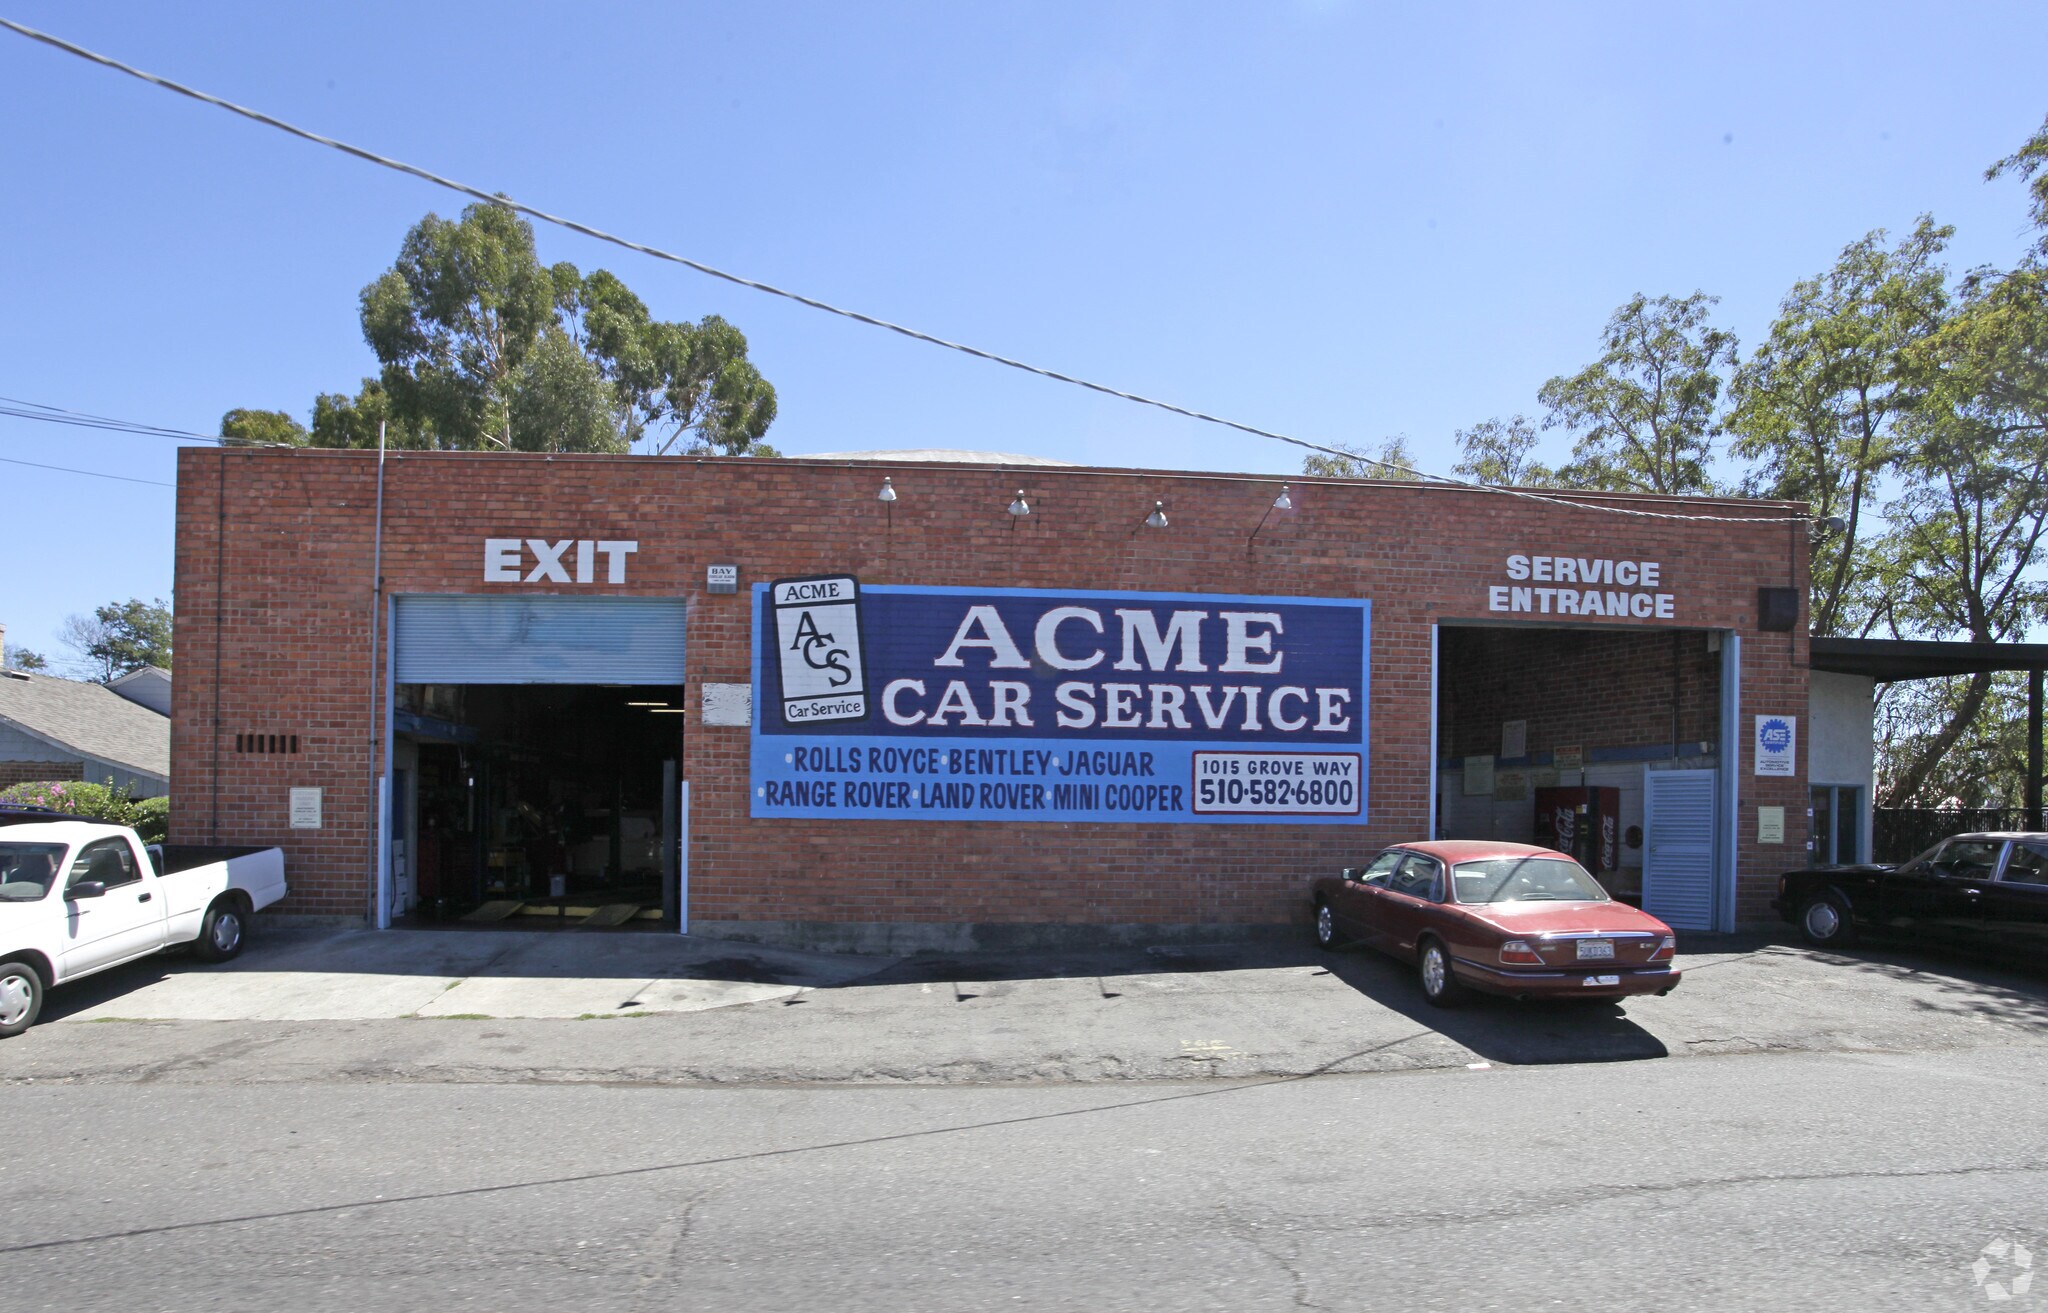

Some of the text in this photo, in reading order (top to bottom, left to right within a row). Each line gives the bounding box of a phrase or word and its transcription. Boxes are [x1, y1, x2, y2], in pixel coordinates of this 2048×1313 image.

[484, 539, 638, 584] EXIT
[1506, 555, 1660, 587] SERVICE
[784, 583, 840, 601] ACME
[1489, 585, 1675, 619] ENTRANCE
[790, 611, 852, 687] ACS
[934, 604, 1284, 674] ACME
[788, 700, 861, 718] Car Service
[881, 678, 1351, 733] CAR SERVICE
[1764, 729, 1786, 741] ASE
[794, 746, 1155, 777] ROLLS ROYCE BENTLEY JAGUAR
[1202, 760, 1352, 776] 1015 GROVE WAY
[765, 780, 1183, 811] RANGE ROVER LAND ROVER MINI COOPER
